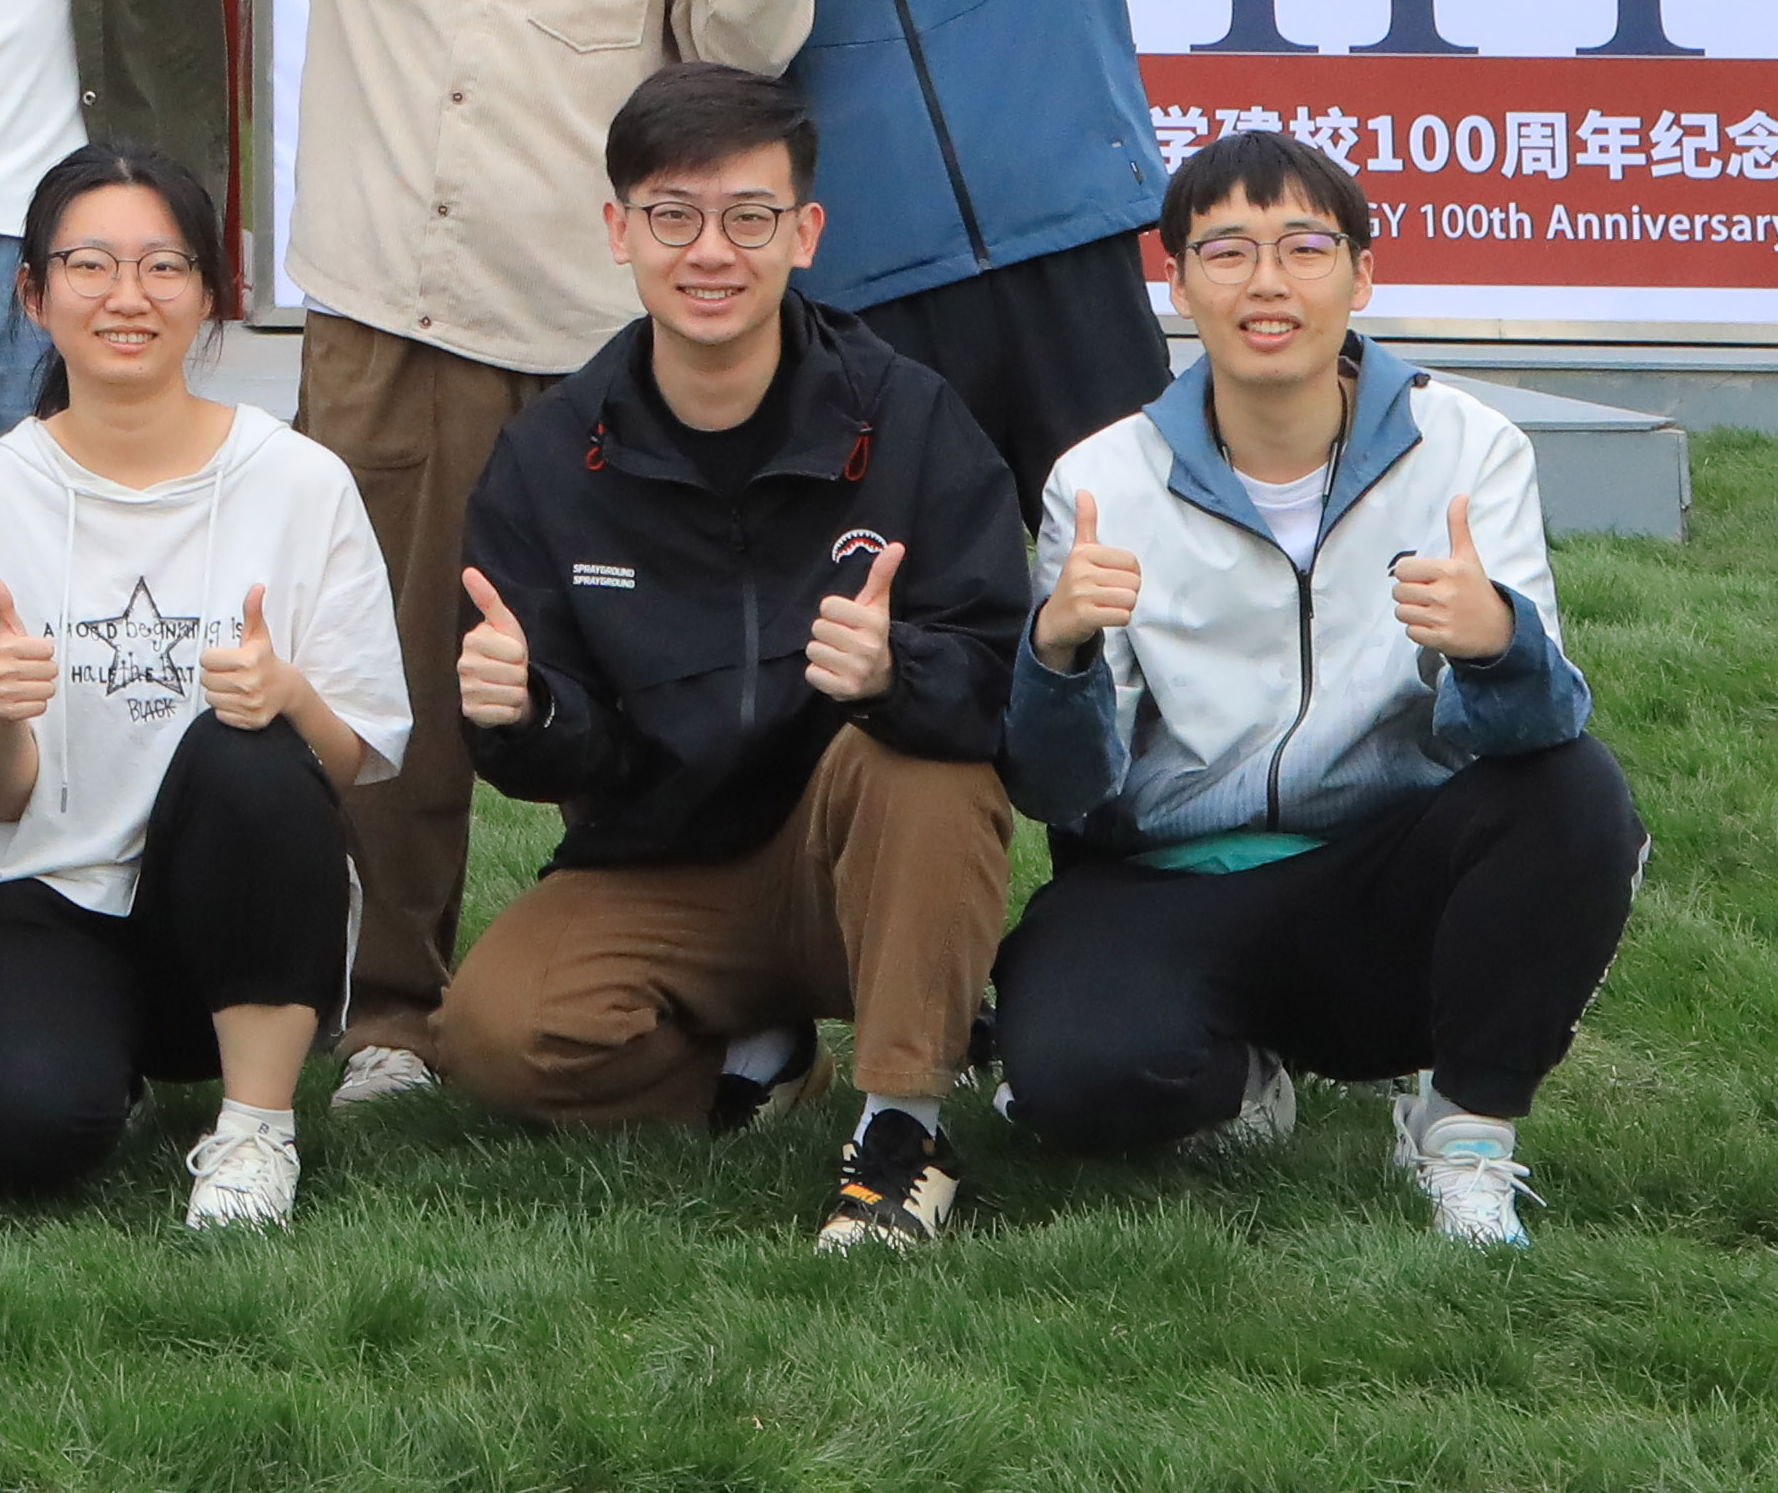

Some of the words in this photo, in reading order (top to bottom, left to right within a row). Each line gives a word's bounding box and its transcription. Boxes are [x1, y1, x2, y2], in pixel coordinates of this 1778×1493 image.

[1420, 202, 1534, 240] 100th
[572, 563, 635, 578] SPRAYGROUND
[572, 575, 635, 589] SPRAYGROUND
